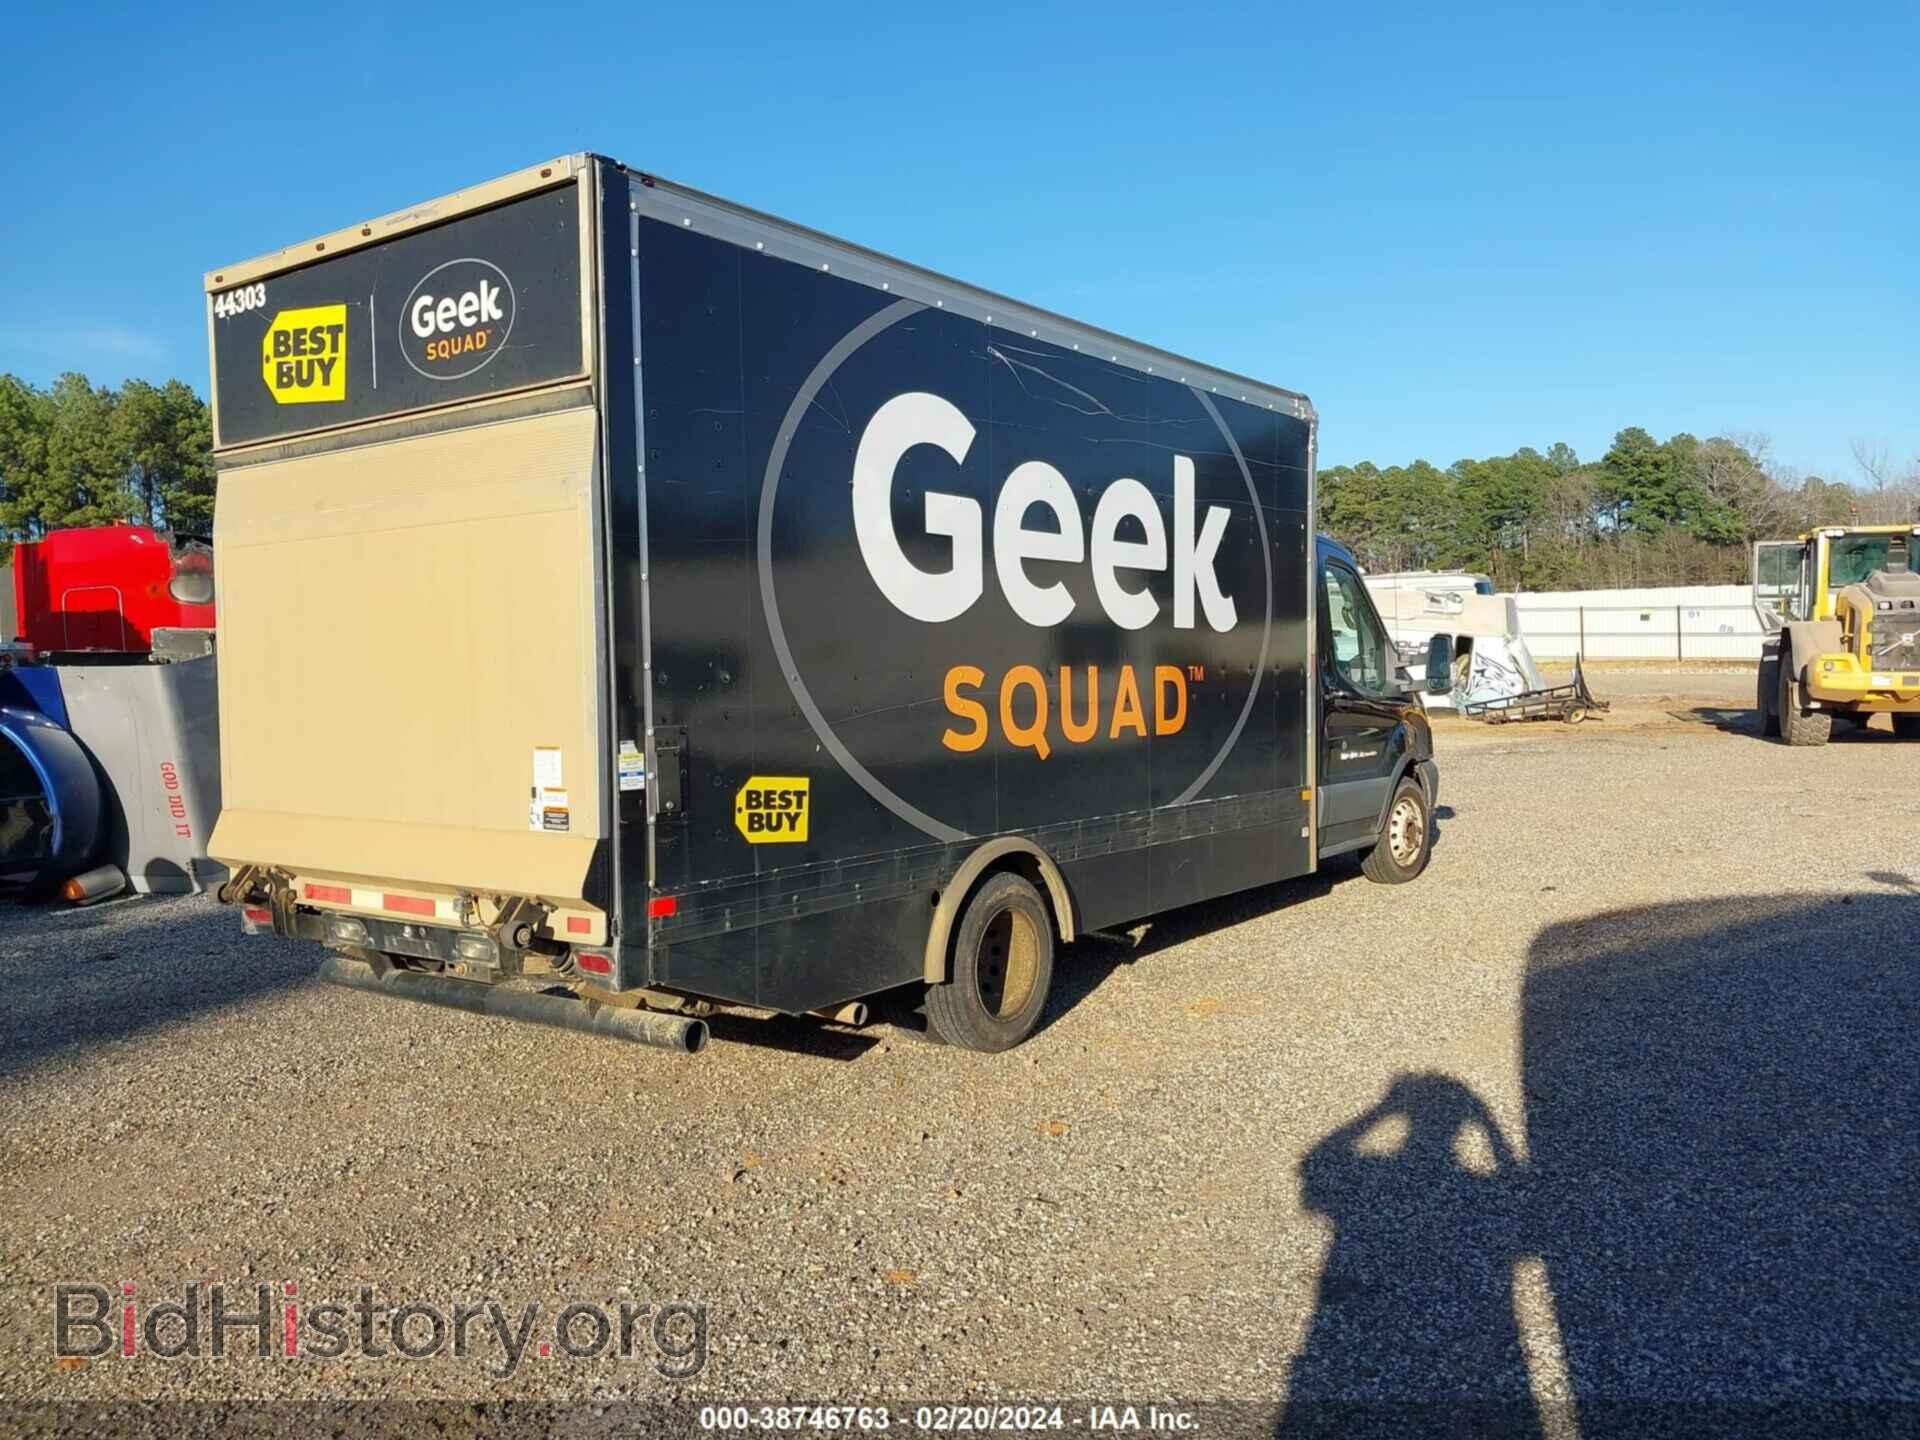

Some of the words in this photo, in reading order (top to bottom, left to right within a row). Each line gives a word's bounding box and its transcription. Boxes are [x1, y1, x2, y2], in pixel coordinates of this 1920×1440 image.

[214, 282, 266, 319] 44303
[411, 279, 503, 338] Geek
[272, 323, 344, 358] BEST
[426, 330, 487, 360] SQUAD
[275, 358, 337, 390] BUY
[851, 391, 1238, 633] Geek
[941, 664, 1188, 761] SQUAD
[161, 762, 178, 789] GOD
[169, 796, 186, 818] DID
[745, 789, 807, 810] BEST
[177, 825, 191, 838] IT
[747, 811, 801, 832] BUY
